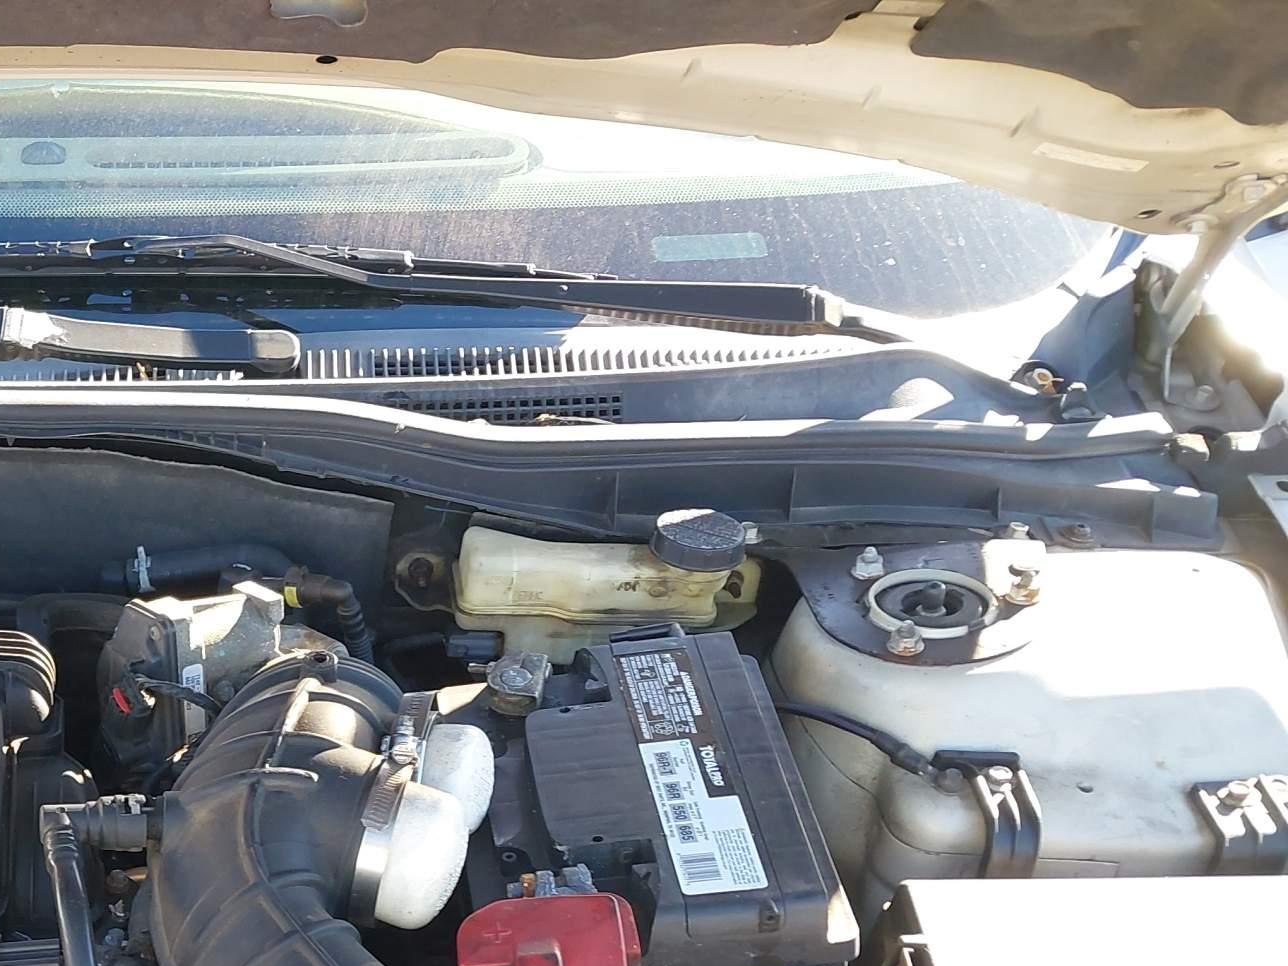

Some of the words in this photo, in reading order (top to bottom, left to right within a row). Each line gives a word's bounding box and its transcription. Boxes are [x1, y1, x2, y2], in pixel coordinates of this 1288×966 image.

[655, 751, 674, 776] 96R-T
[666, 783, 681, 799] 96R
[672, 805, 687, 821] 550
[679, 825, 694, 841] 685
